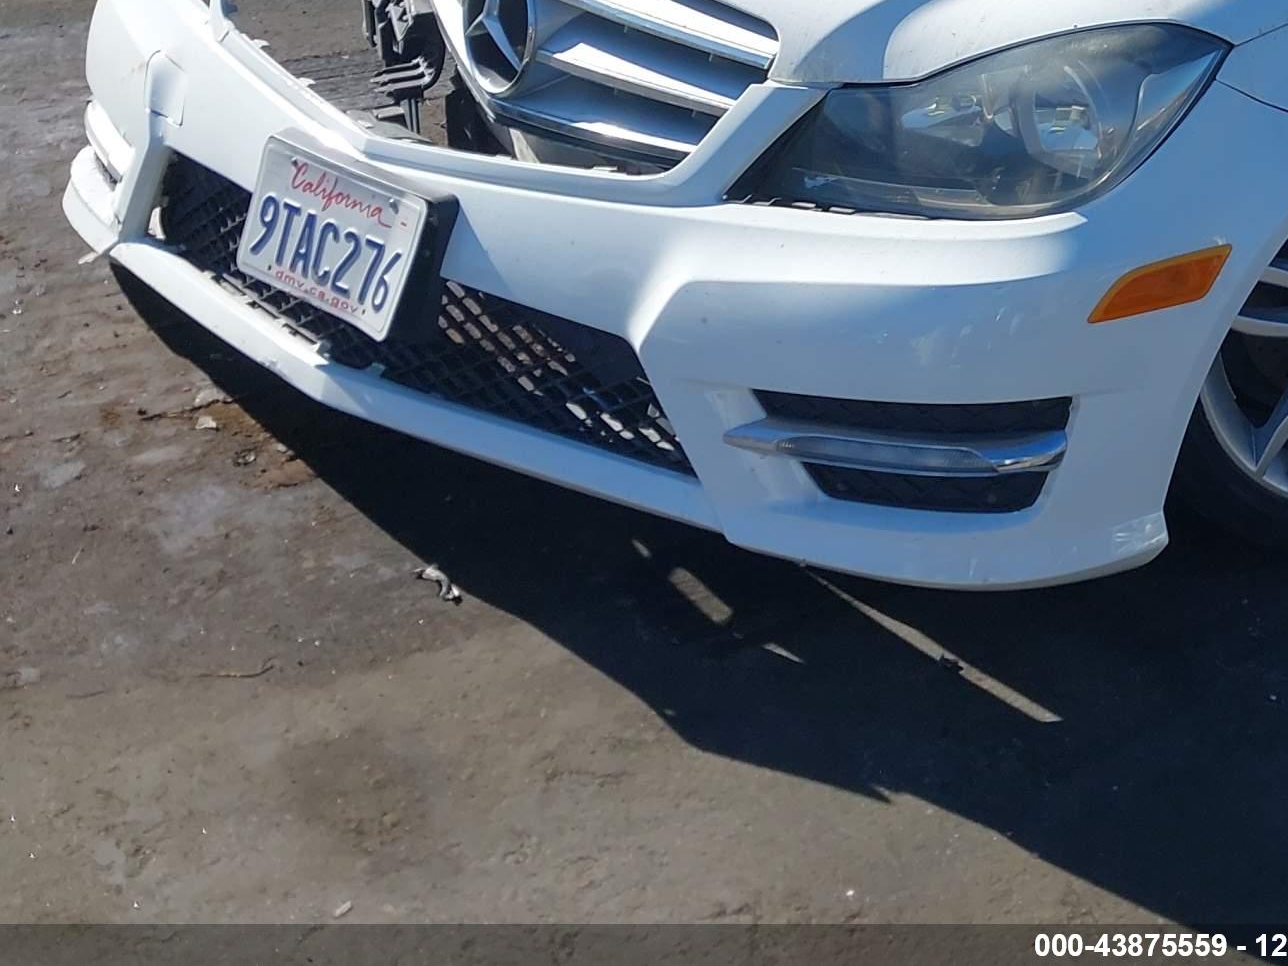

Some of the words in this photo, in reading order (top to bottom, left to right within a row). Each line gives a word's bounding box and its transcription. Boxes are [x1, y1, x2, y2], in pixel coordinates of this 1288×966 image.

[291, 161, 393, 229] California
[249, 193, 403, 315] 9TAC276
[274, 268, 360, 316] dmv.ca.gov
